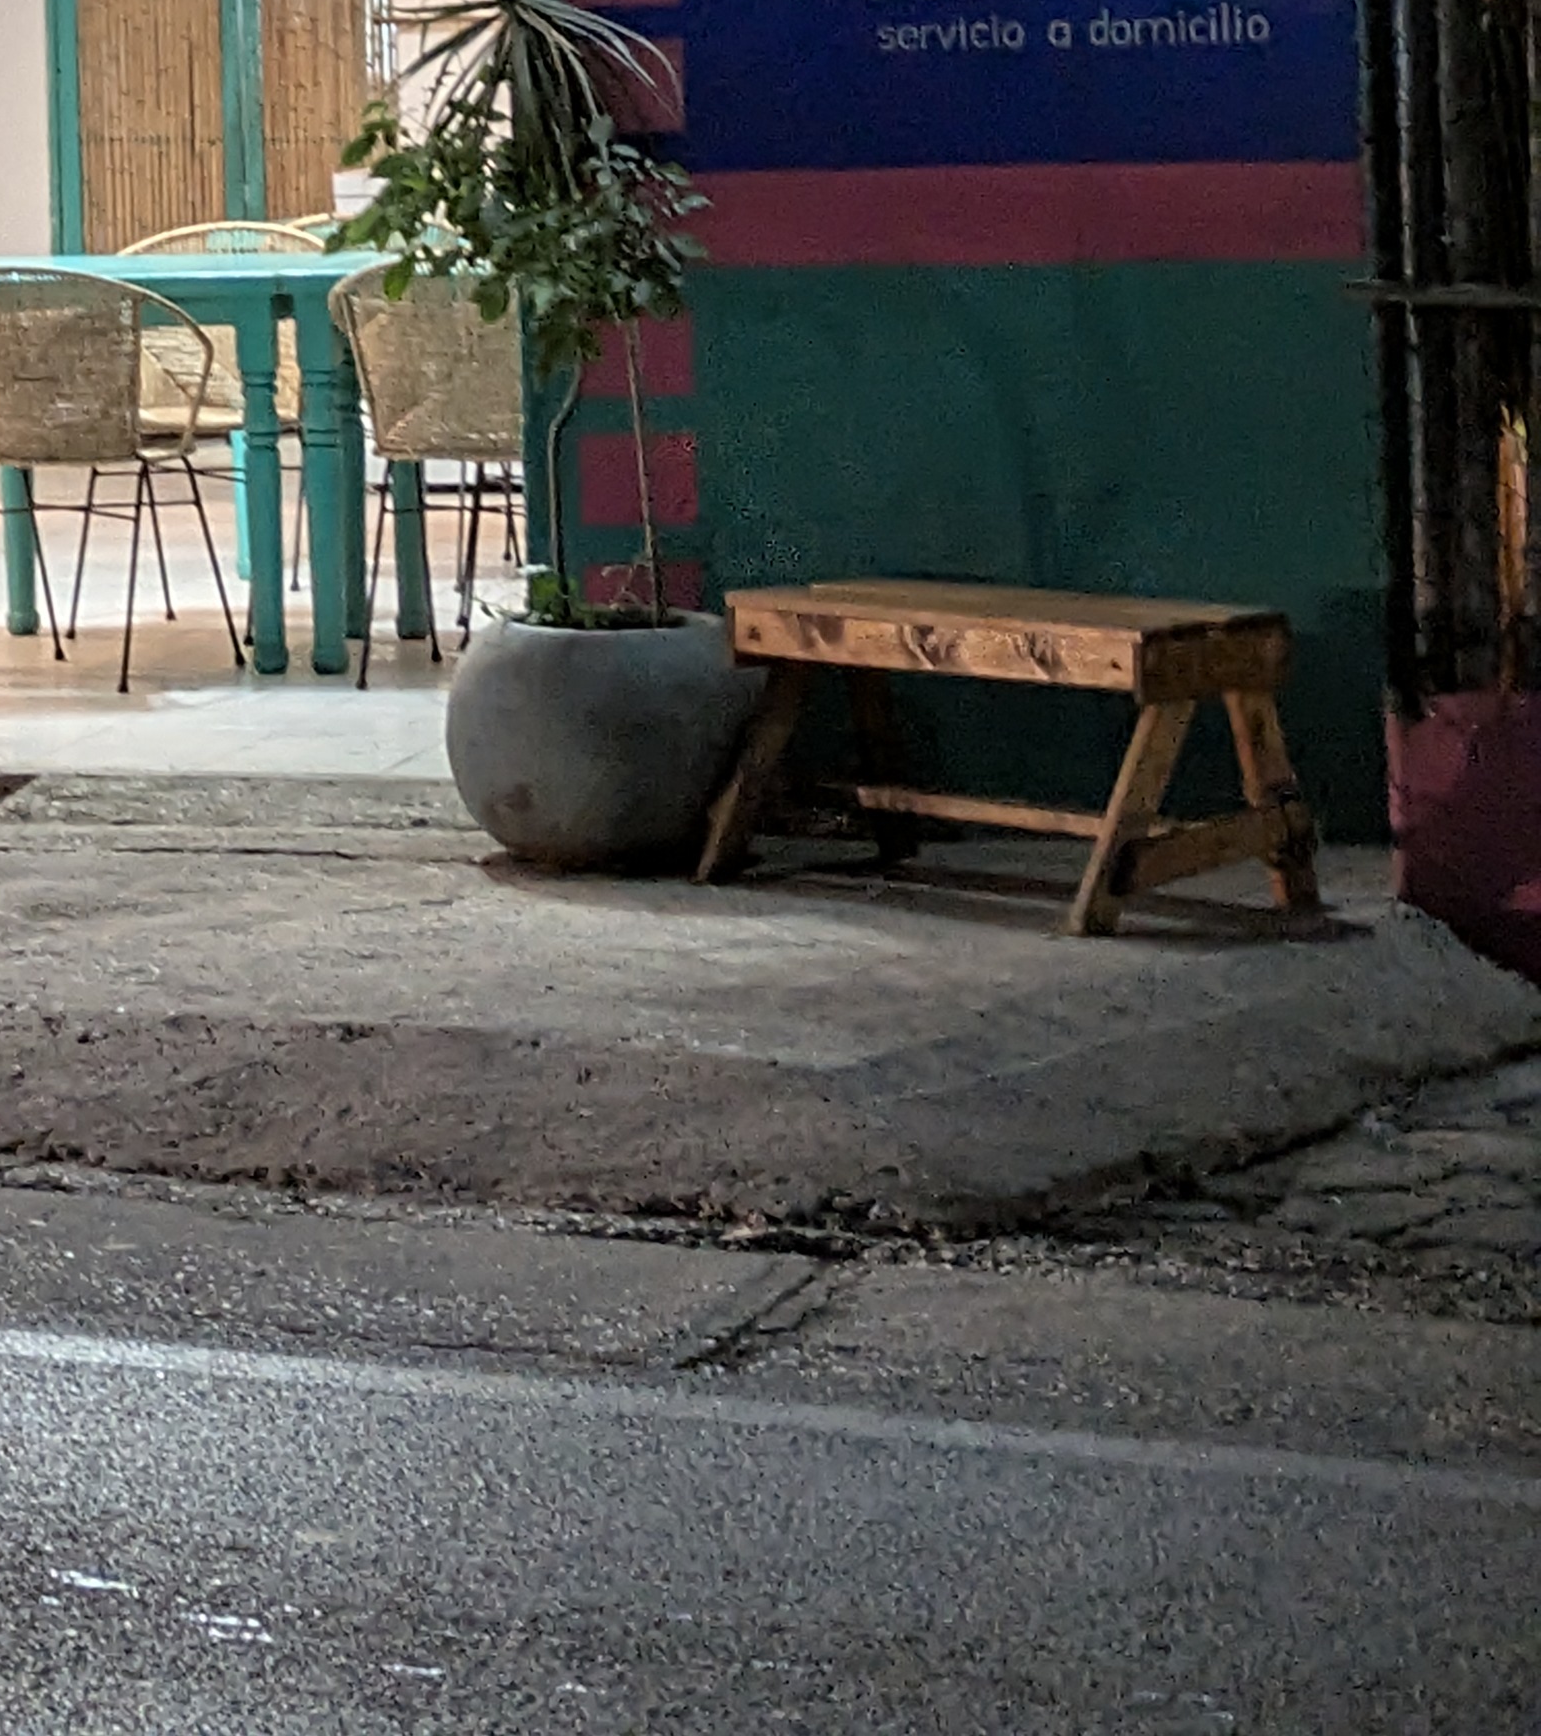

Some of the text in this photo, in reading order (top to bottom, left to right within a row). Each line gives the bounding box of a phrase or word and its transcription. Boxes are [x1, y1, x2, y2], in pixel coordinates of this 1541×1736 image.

[878, 2, 1271, 52] servicio a domicilio
